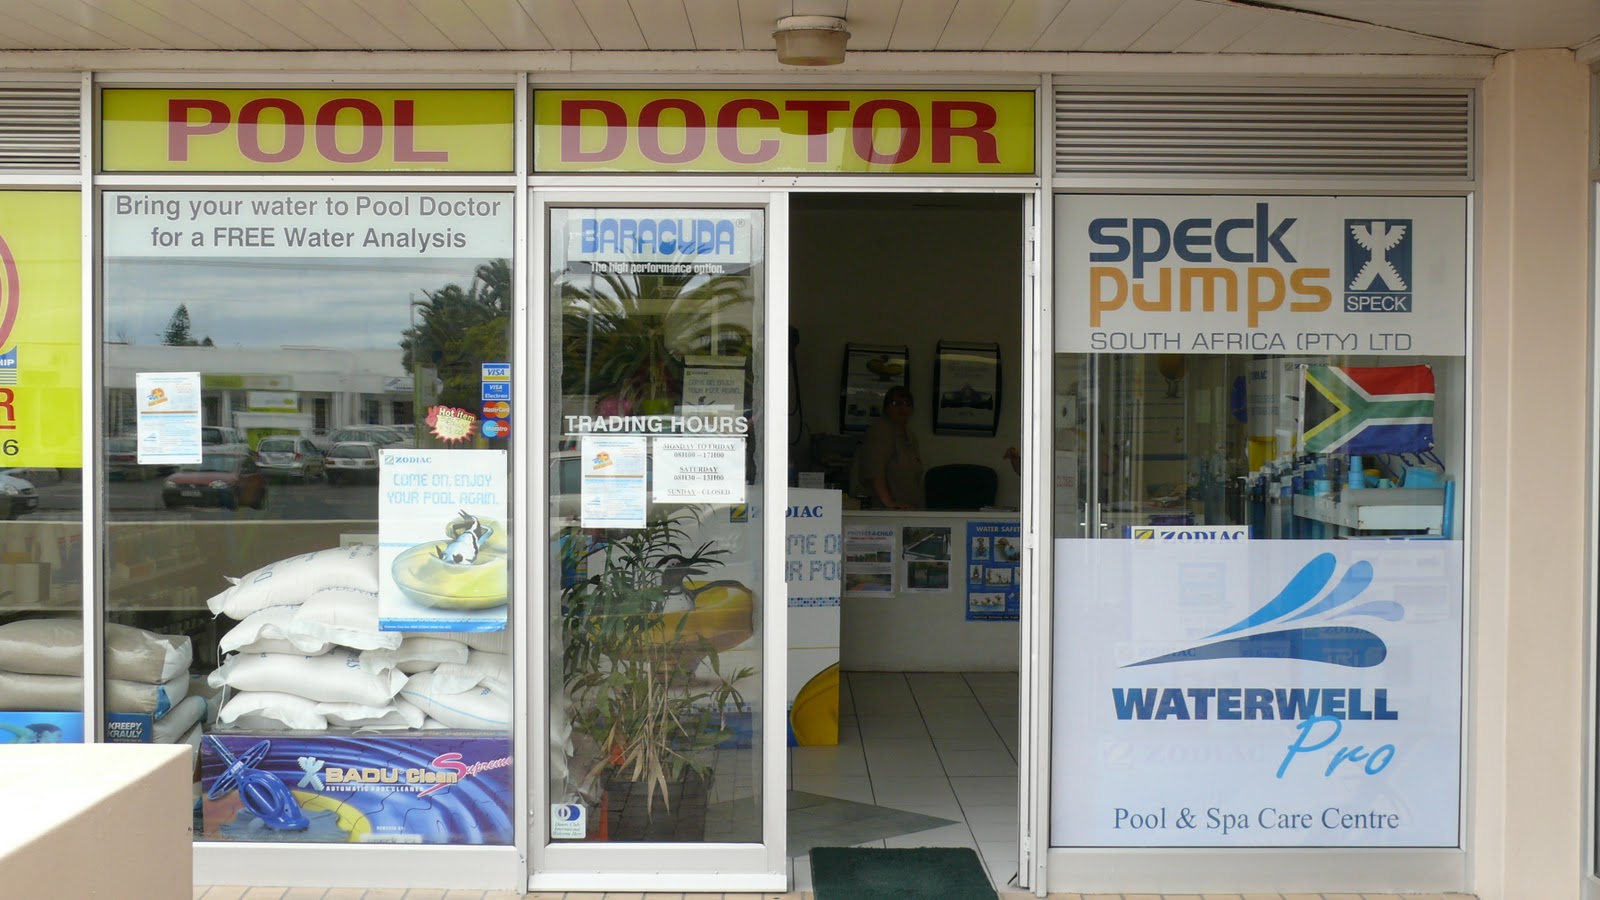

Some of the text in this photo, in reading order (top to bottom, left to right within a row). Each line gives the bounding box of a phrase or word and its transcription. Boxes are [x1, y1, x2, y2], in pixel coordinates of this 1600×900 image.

[168, 98, 1001, 165] POOL DOCTOR
[115, 195, 502, 220] Bring your water to Pool Doctor
[151, 226, 467, 254] for a FREE Water Analysis
[581, 218, 735, 255] BARACUDA
[591, 262, 726, 275] The high performance option.
[1089, 267, 1332, 328] pumps
[1346, 295, 1408, 311] SPECK
[1091, 332, 1412, 351] SOUTH AFRICA (PTY) LTD
[438, 407, 476, 422] Hot item
[564, 415, 749, 433] TRADING HOURS
[2, 439, 19, 456] 6
[393, 473, 429, 487] COME
[454, 474, 492, 488] ENJOY
[387, 491, 499, 505] YOUR POOL AGAIN.
[1112, 688, 1398, 720] WATERWELL
[108, 722, 142, 730] KREEPY
[108, 730, 142, 738] KRAULY
[1276, 715, 1396, 778] Pro
[325, 768, 398, 783] BADU
[406, 768, 458, 783] Clean
[1113, 807, 1399, 834] Pool & Spa Care Centre
